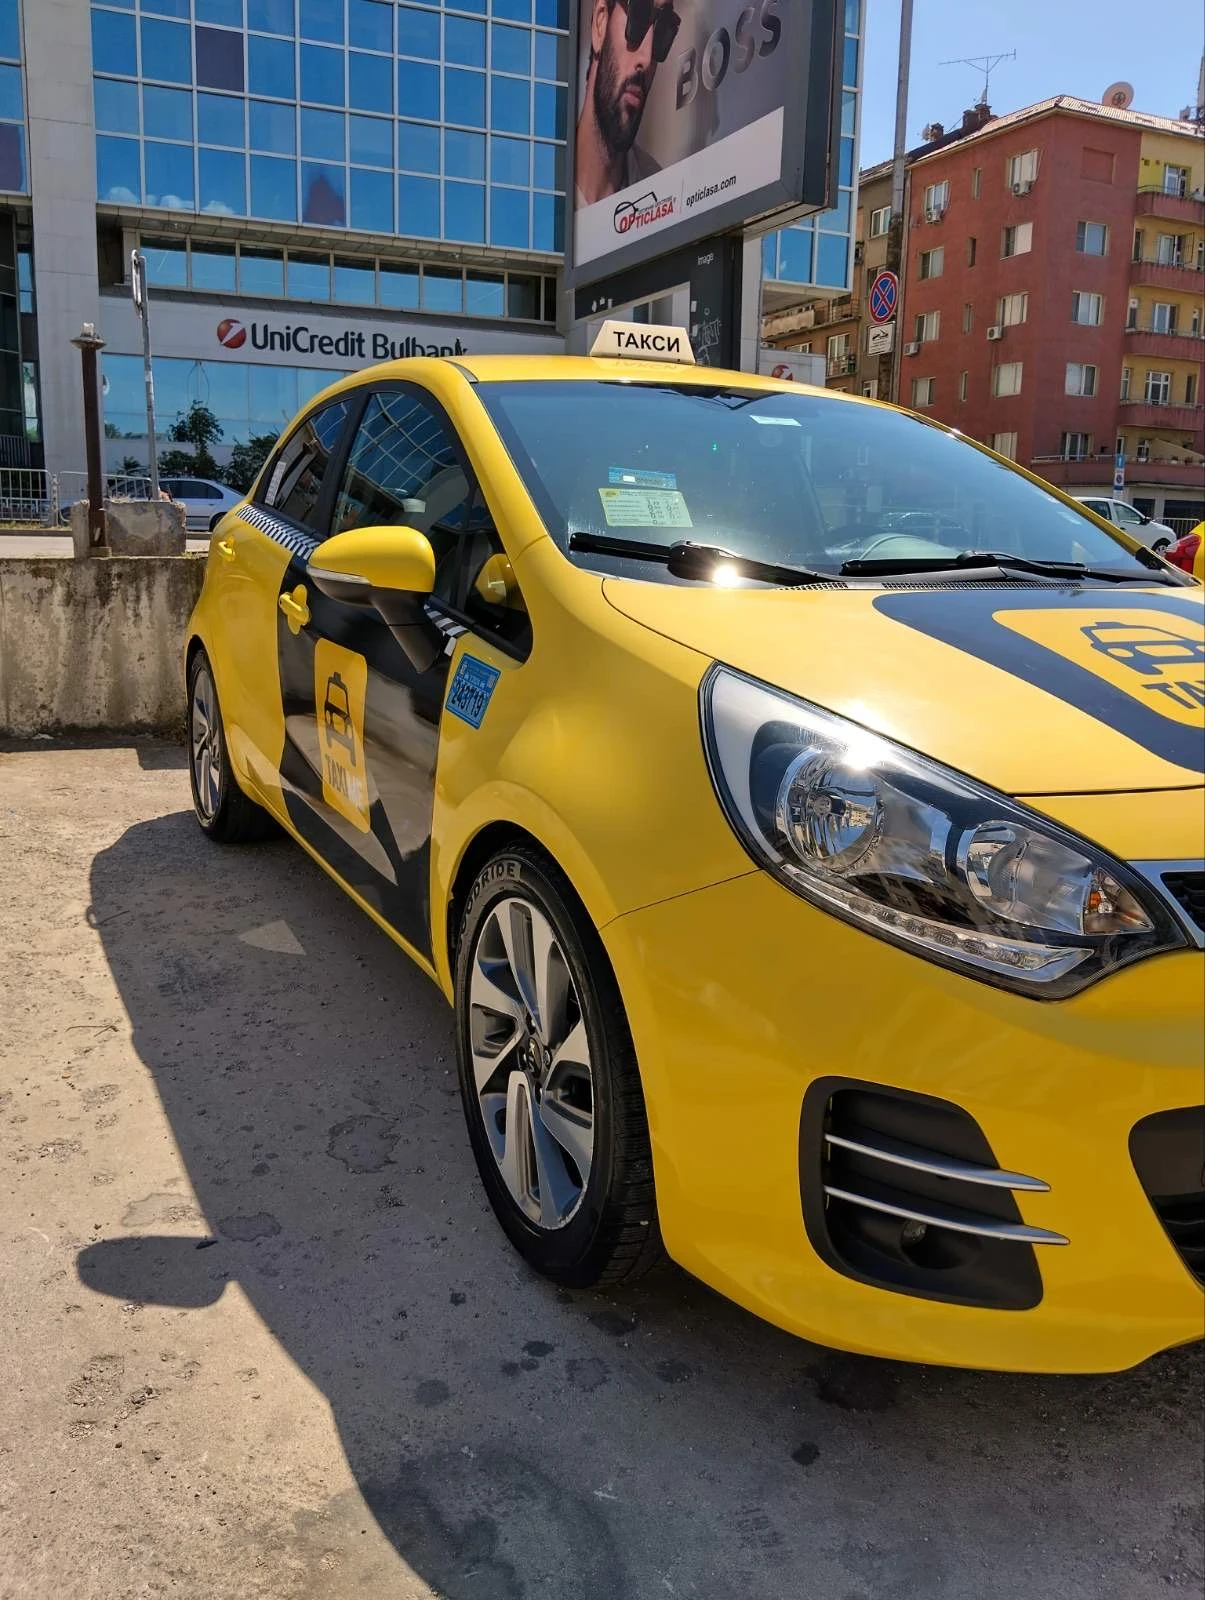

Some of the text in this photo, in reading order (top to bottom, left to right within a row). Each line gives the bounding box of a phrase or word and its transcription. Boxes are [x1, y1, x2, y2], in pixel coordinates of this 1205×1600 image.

[675, 0, 781, 111] BOSS
[686, 175, 737, 207] opticlasa.com
[619, 201, 674, 233] OPTICLASA
[251, 323, 468, 360] UniCredit Bulbank
[613, 331, 680, 353] ТАКСИ
